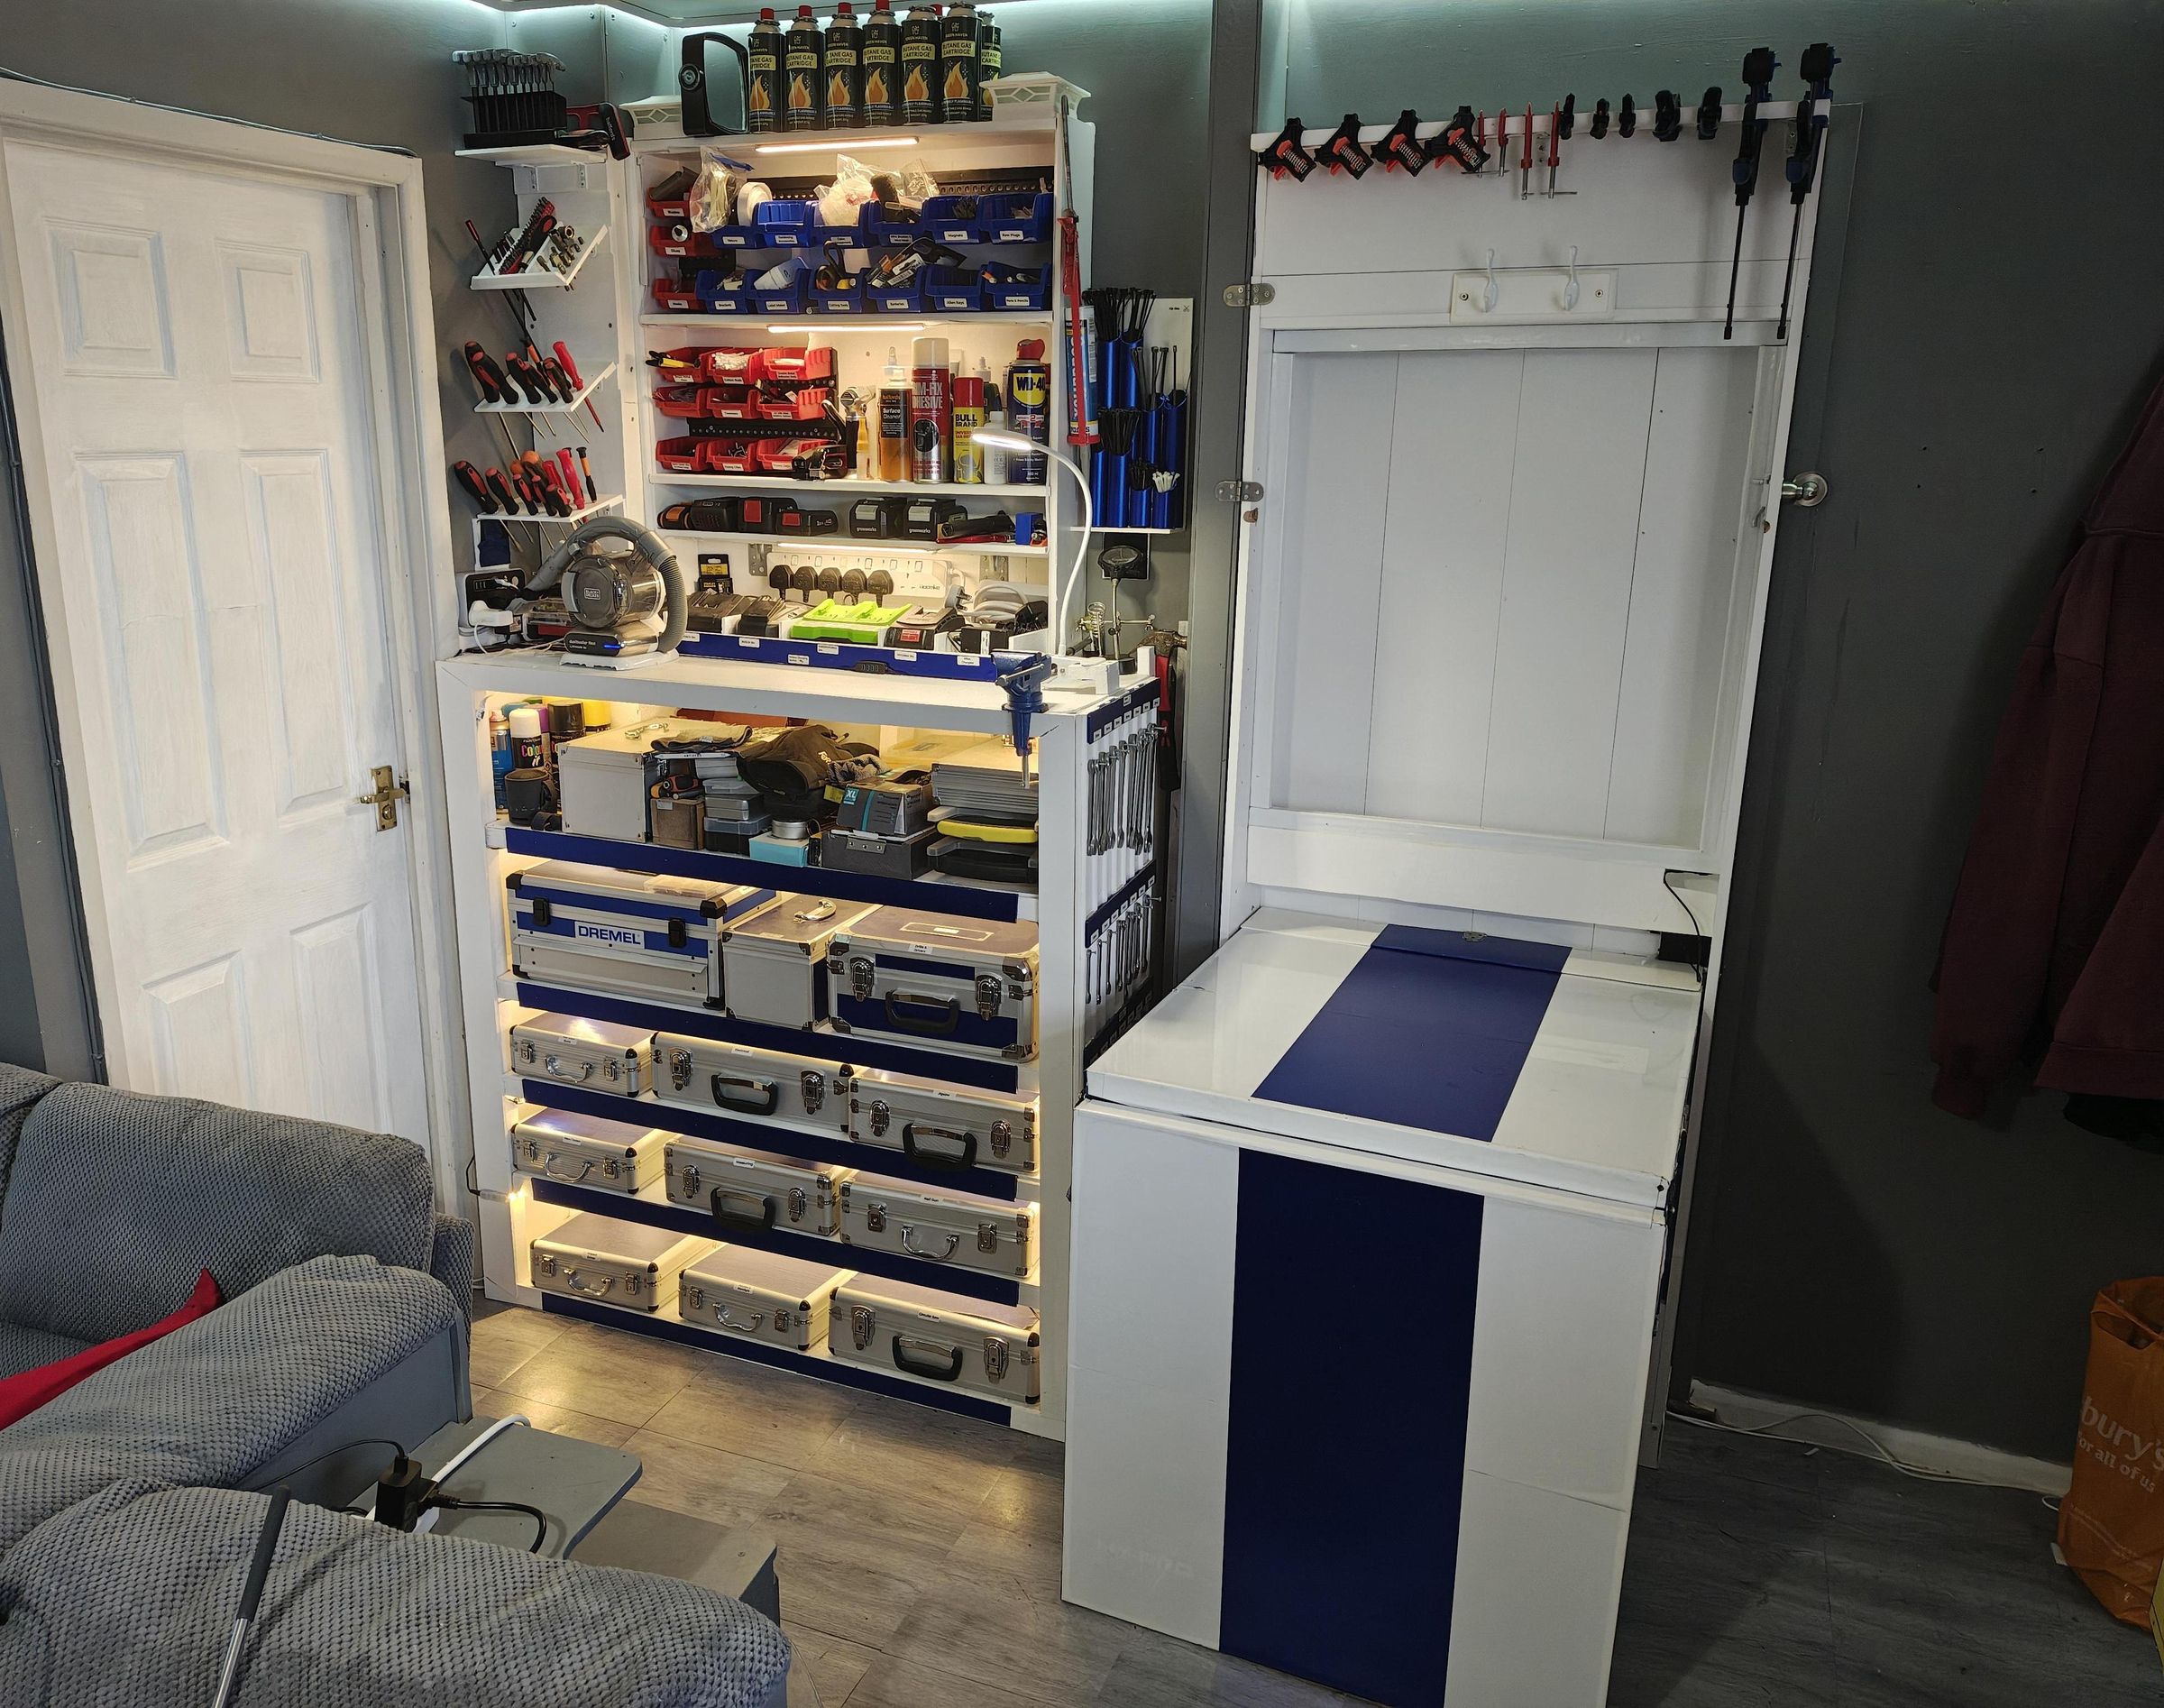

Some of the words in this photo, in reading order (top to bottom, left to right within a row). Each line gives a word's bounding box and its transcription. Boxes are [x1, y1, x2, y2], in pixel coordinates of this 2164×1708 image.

[955, 414, 977, 422] BULL
[846, 789, 857, 798] XL
[578, 924, 641, 946] DREMEL
[2095, 1449, 2116, 1468] all
[2120, 1465, 2141, 1480] of
[2140, 1475, 2156, 1493] us
